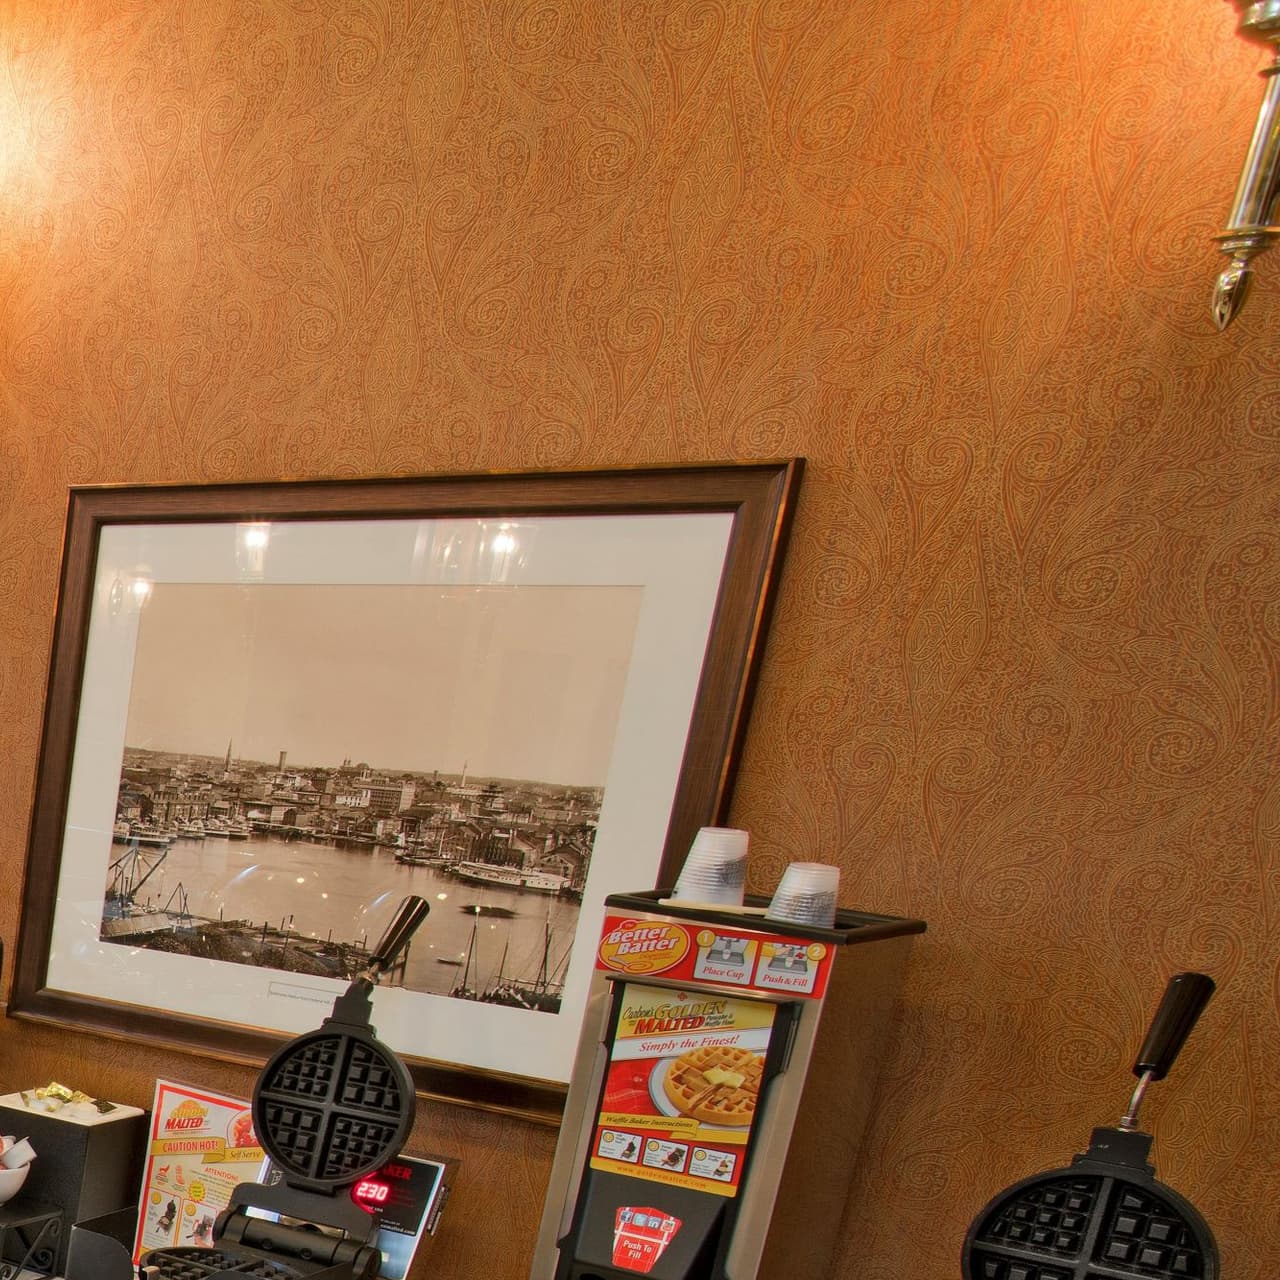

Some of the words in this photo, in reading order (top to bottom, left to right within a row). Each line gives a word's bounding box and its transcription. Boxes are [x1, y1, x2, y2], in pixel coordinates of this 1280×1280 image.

[608, 927, 671, 944] Better
[617, 937, 680, 955] Batter
[702, 966, 724, 976] Place
[726, 968, 745, 980] Cup
[762, 974, 783, 984] Push
[791, 977, 808, 987] Fill
[654, 1000, 728, 1020] GOLDEN
[633, 1016, 706, 1035] MALTED
[639, 1040, 677, 1052] Simply
[680, 1038, 699, 1048] the
[700, 1035, 740, 1047] Finest!
[165, 1117, 204, 1130] MALTED
[650, 1119, 693, 1128] Instructions
[162, 1141, 198, 1153] CAUTION
[200, 1141, 218, 1151] HOT!
[230, 1151, 241, 1159] Self
[242, 1150, 261, 1158] Serve
[383, 1164, 413, 1180] KER
[623, 1240, 642, 1251] Push
[643, 1244, 652, 1253] To
[628, 1250, 642, 1259] Fill
